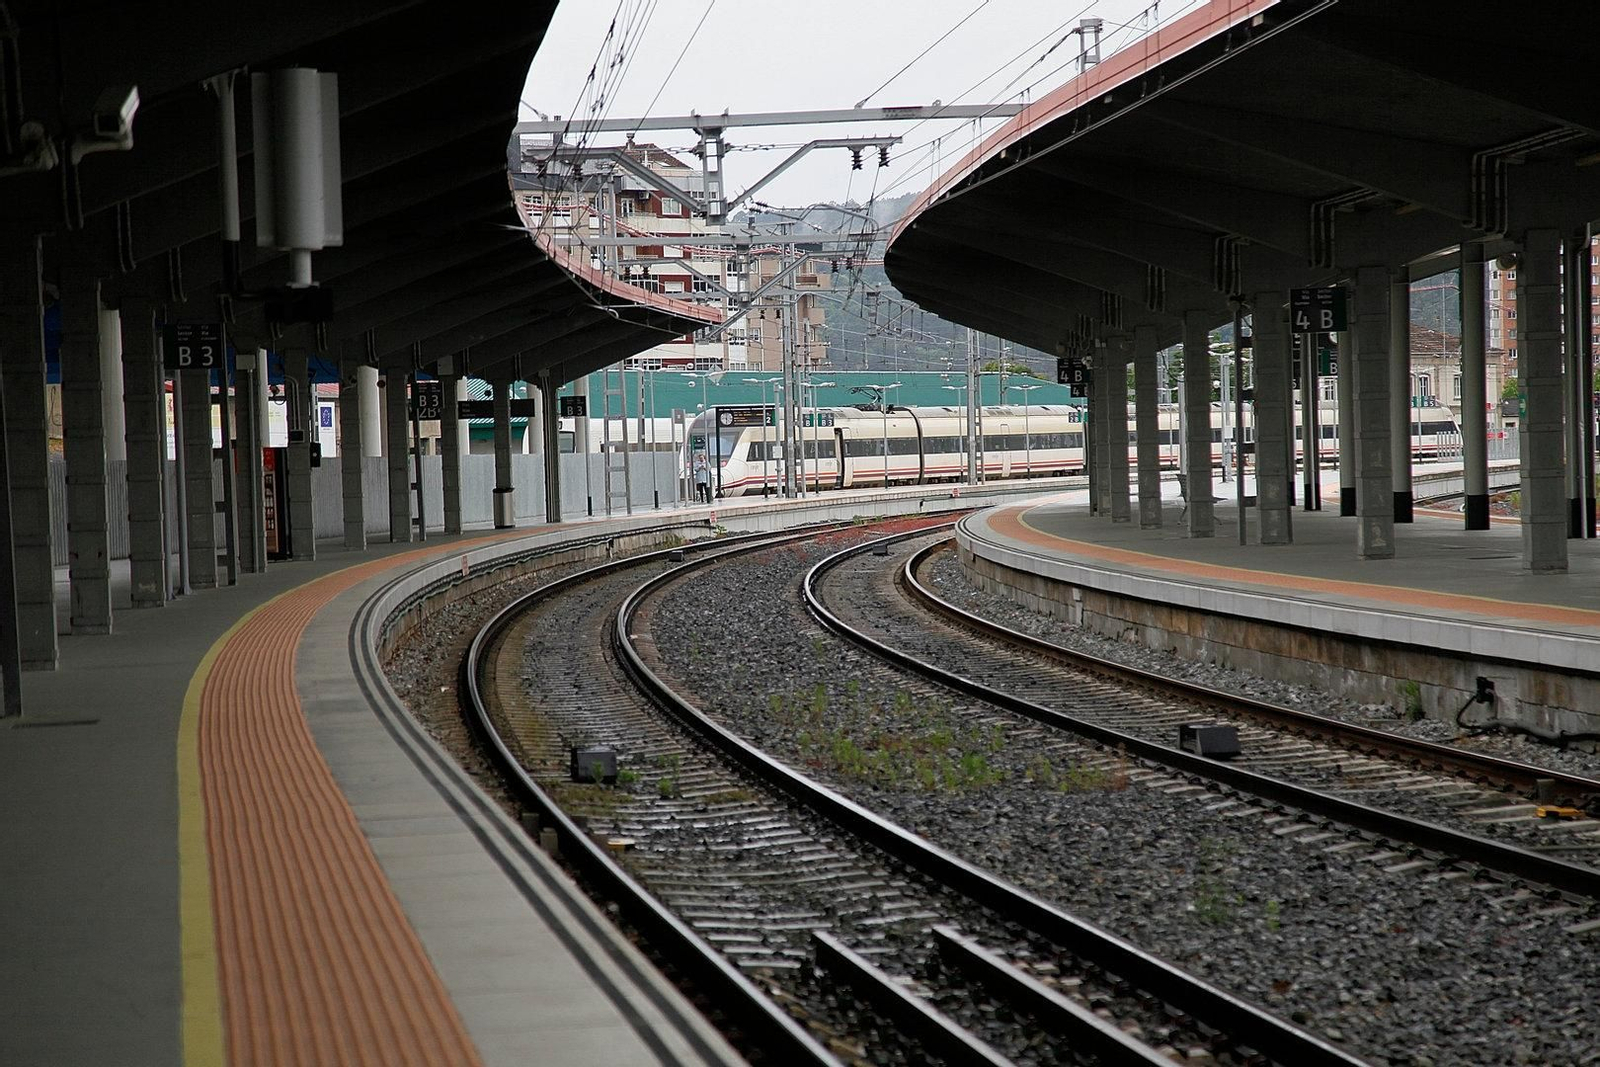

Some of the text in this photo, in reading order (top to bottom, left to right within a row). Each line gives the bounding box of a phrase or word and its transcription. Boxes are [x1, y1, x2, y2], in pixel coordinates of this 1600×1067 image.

[1295, 309, 1334, 330] 4 B
[179, 345, 214, 366] B 3
[1330, 362, 1338, 374] B
[1060, 369, 1083, 382] 4 B
[1073, 386, 1080, 396] 4
[419, 394, 439, 407] B 3
[567, 405, 583, 416] B 3
[765, 416, 772, 424] 2
[821, 419, 833, 427] B 3
